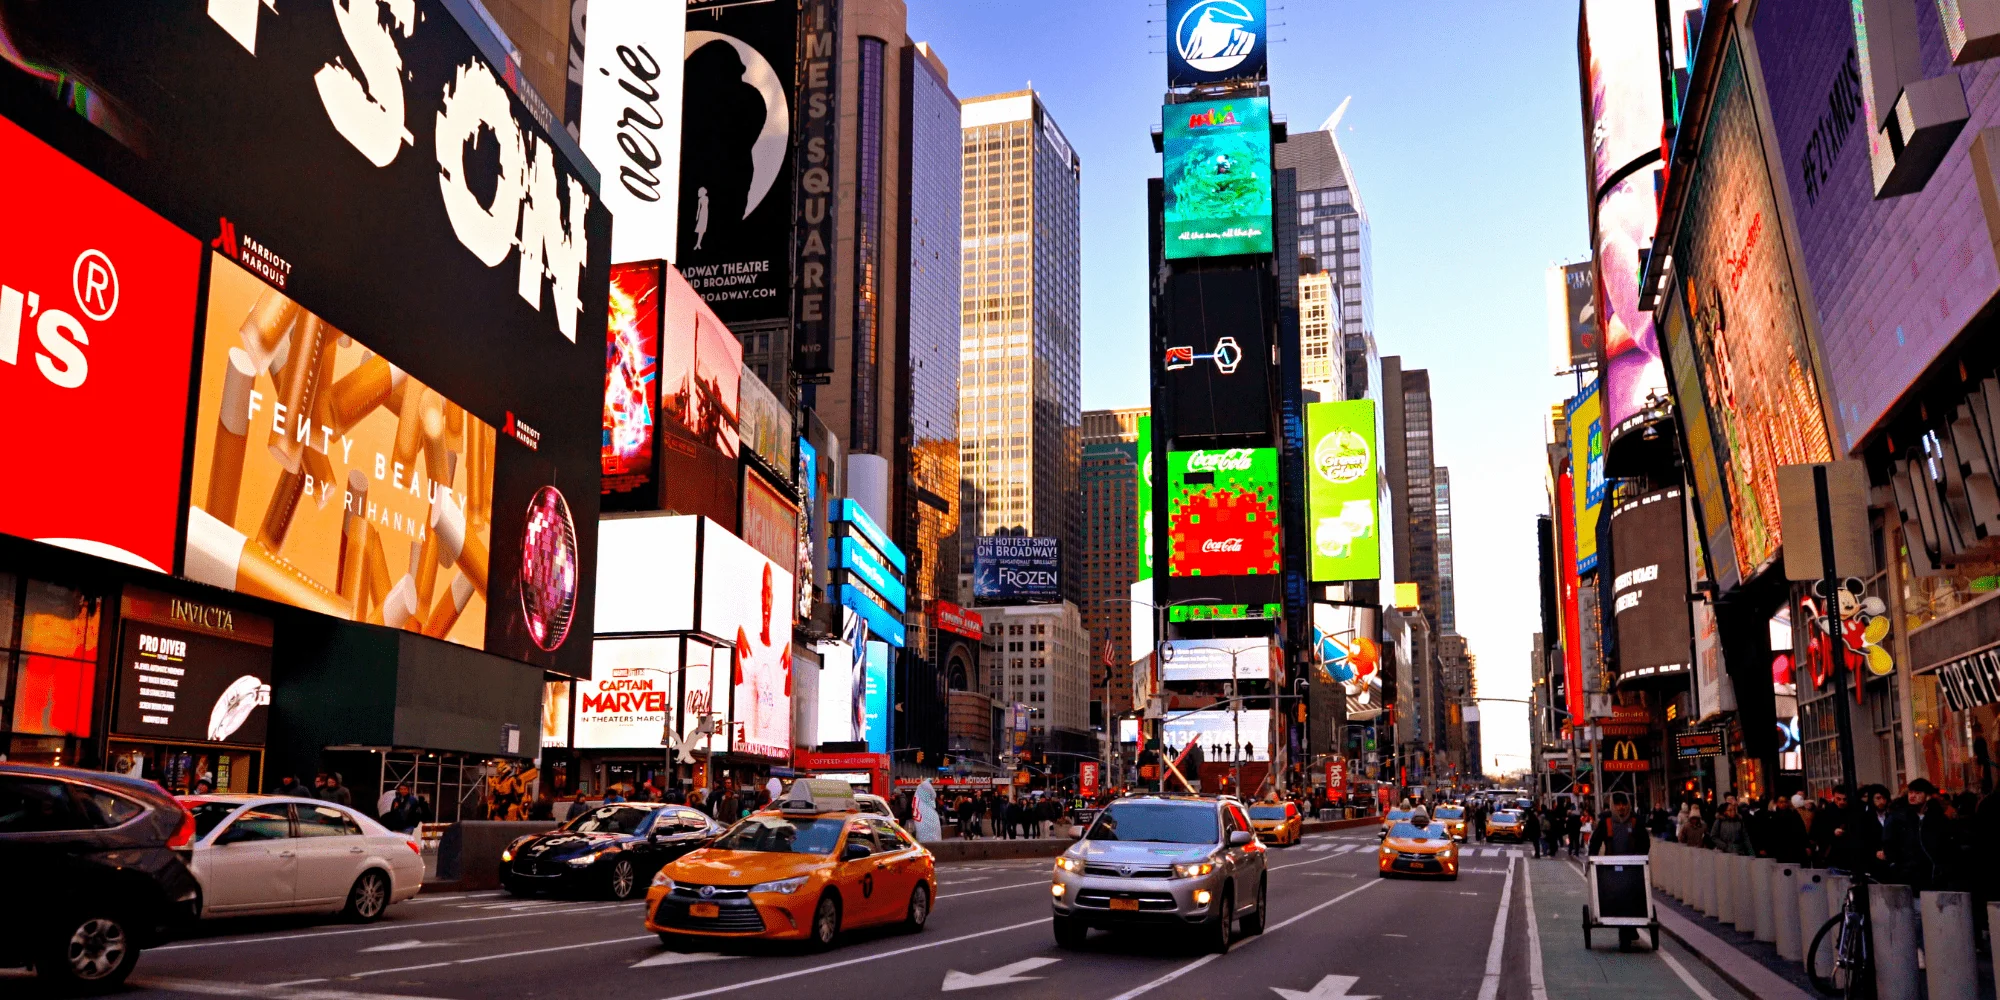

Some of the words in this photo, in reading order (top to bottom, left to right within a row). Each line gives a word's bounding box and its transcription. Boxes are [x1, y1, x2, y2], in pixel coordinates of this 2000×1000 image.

[520, 78, 554, 124] MARRIOTT
[600, 45, 664, 202] aerie
[435, 56, 590, 344] ON
[801, 137, 831, 322] SQUARE
[244, 234, 292, 274] MARRIOTT
[242, 250, 285, 286] MARQUIS
[722, 260, 769, 275] THEATRE
[703, 274, 758, 288] BROADWAY
[801, 344, 821, 352] NYC
[248, 389, 354, 464] FENTY
[1187, 448, 1255, 473] Coca-Cola
[304, 474, 329, 501] BY
[375, 452, 467, 514] BEAUTY
[344, 491, 426, 541] RIHANNA
[977, 546, 993, 556] ON
[996, 546, 1057, 557] BROADWAY!
[996, 538, 1030, 546] HOTTEST
[1033, 538, 1057, 546] SNOW
[1202, 538, 1244, 552] Coca-Cola
[998, 567, 1057, 589] FROZEN
[1633, 564, 1658, 584] WOMEN
[170, 599, 234, 631] INVICTA
[139, 634, 158, 652] PRO
[160, 637, 187, 657] DIVER
[599, 679, 653, 692] CAPTAIN
[582, 692, 673, 713] MARVEL
[1084, 764, 1093, 786] tkts
[1330, 764, 1341, 787] tkts
